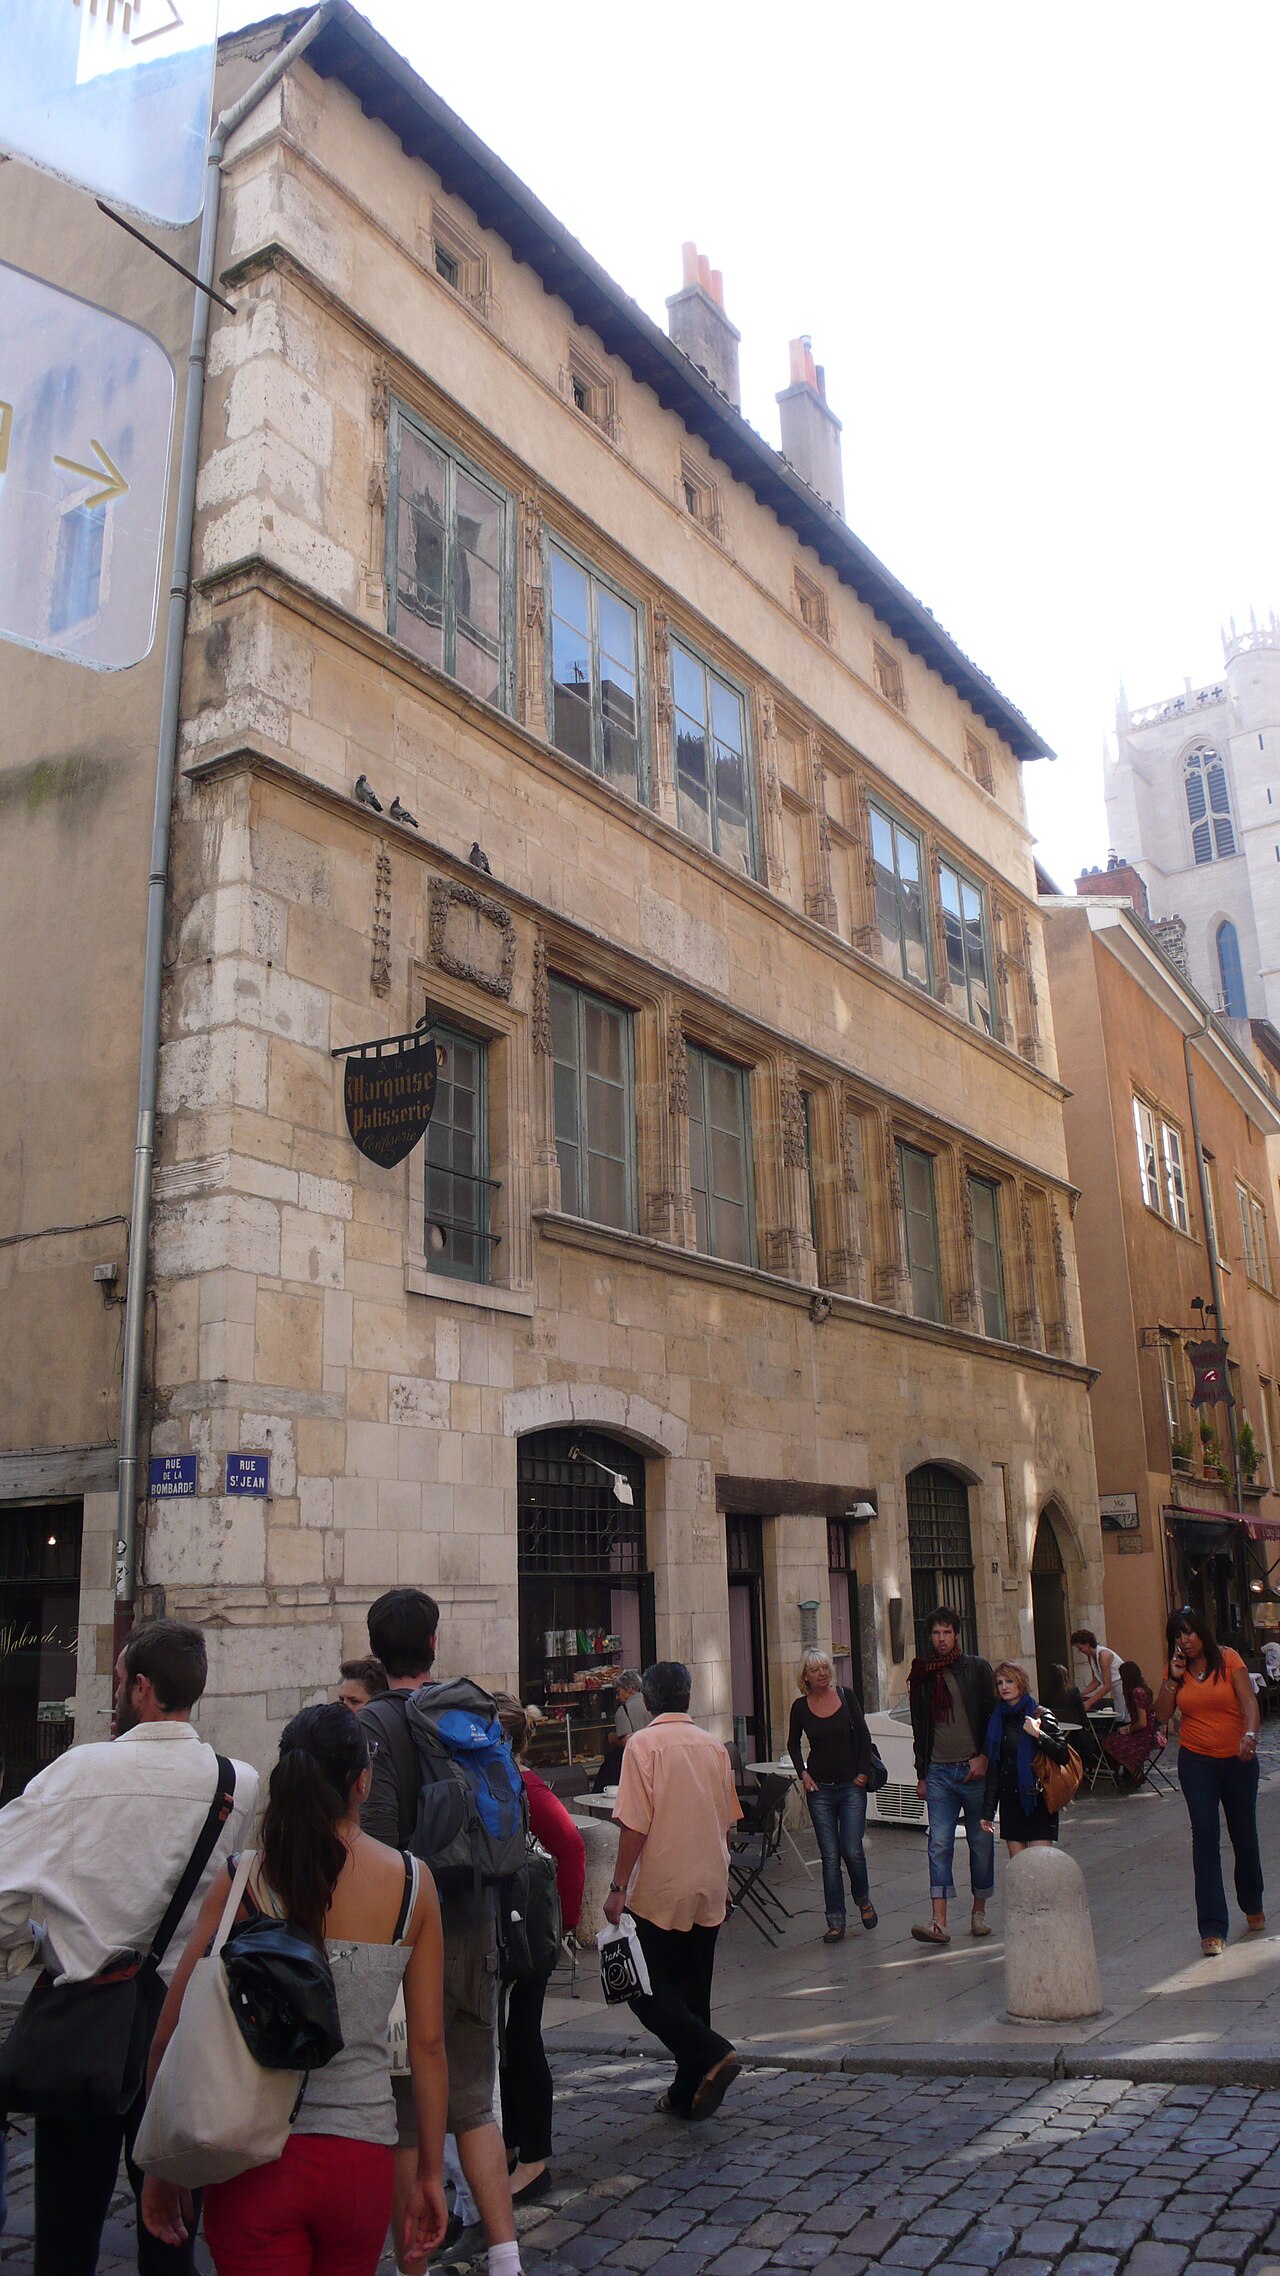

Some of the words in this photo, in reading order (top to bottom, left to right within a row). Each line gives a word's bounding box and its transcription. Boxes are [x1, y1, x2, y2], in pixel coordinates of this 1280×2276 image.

[347, 1070, 434, 1105] Marquise
[165, 1458, 181, 1469] RUE
[239, 1460, 256, 1471] RUE
[163, 1471, 171, 1480] DE
[174, 1471, 183, 1480] LA
[240, 1477, 265, 1488] JEAN
[151, 1482, 194, 1495] BOMBARDE
[41, 1625, 58, 1644] de
